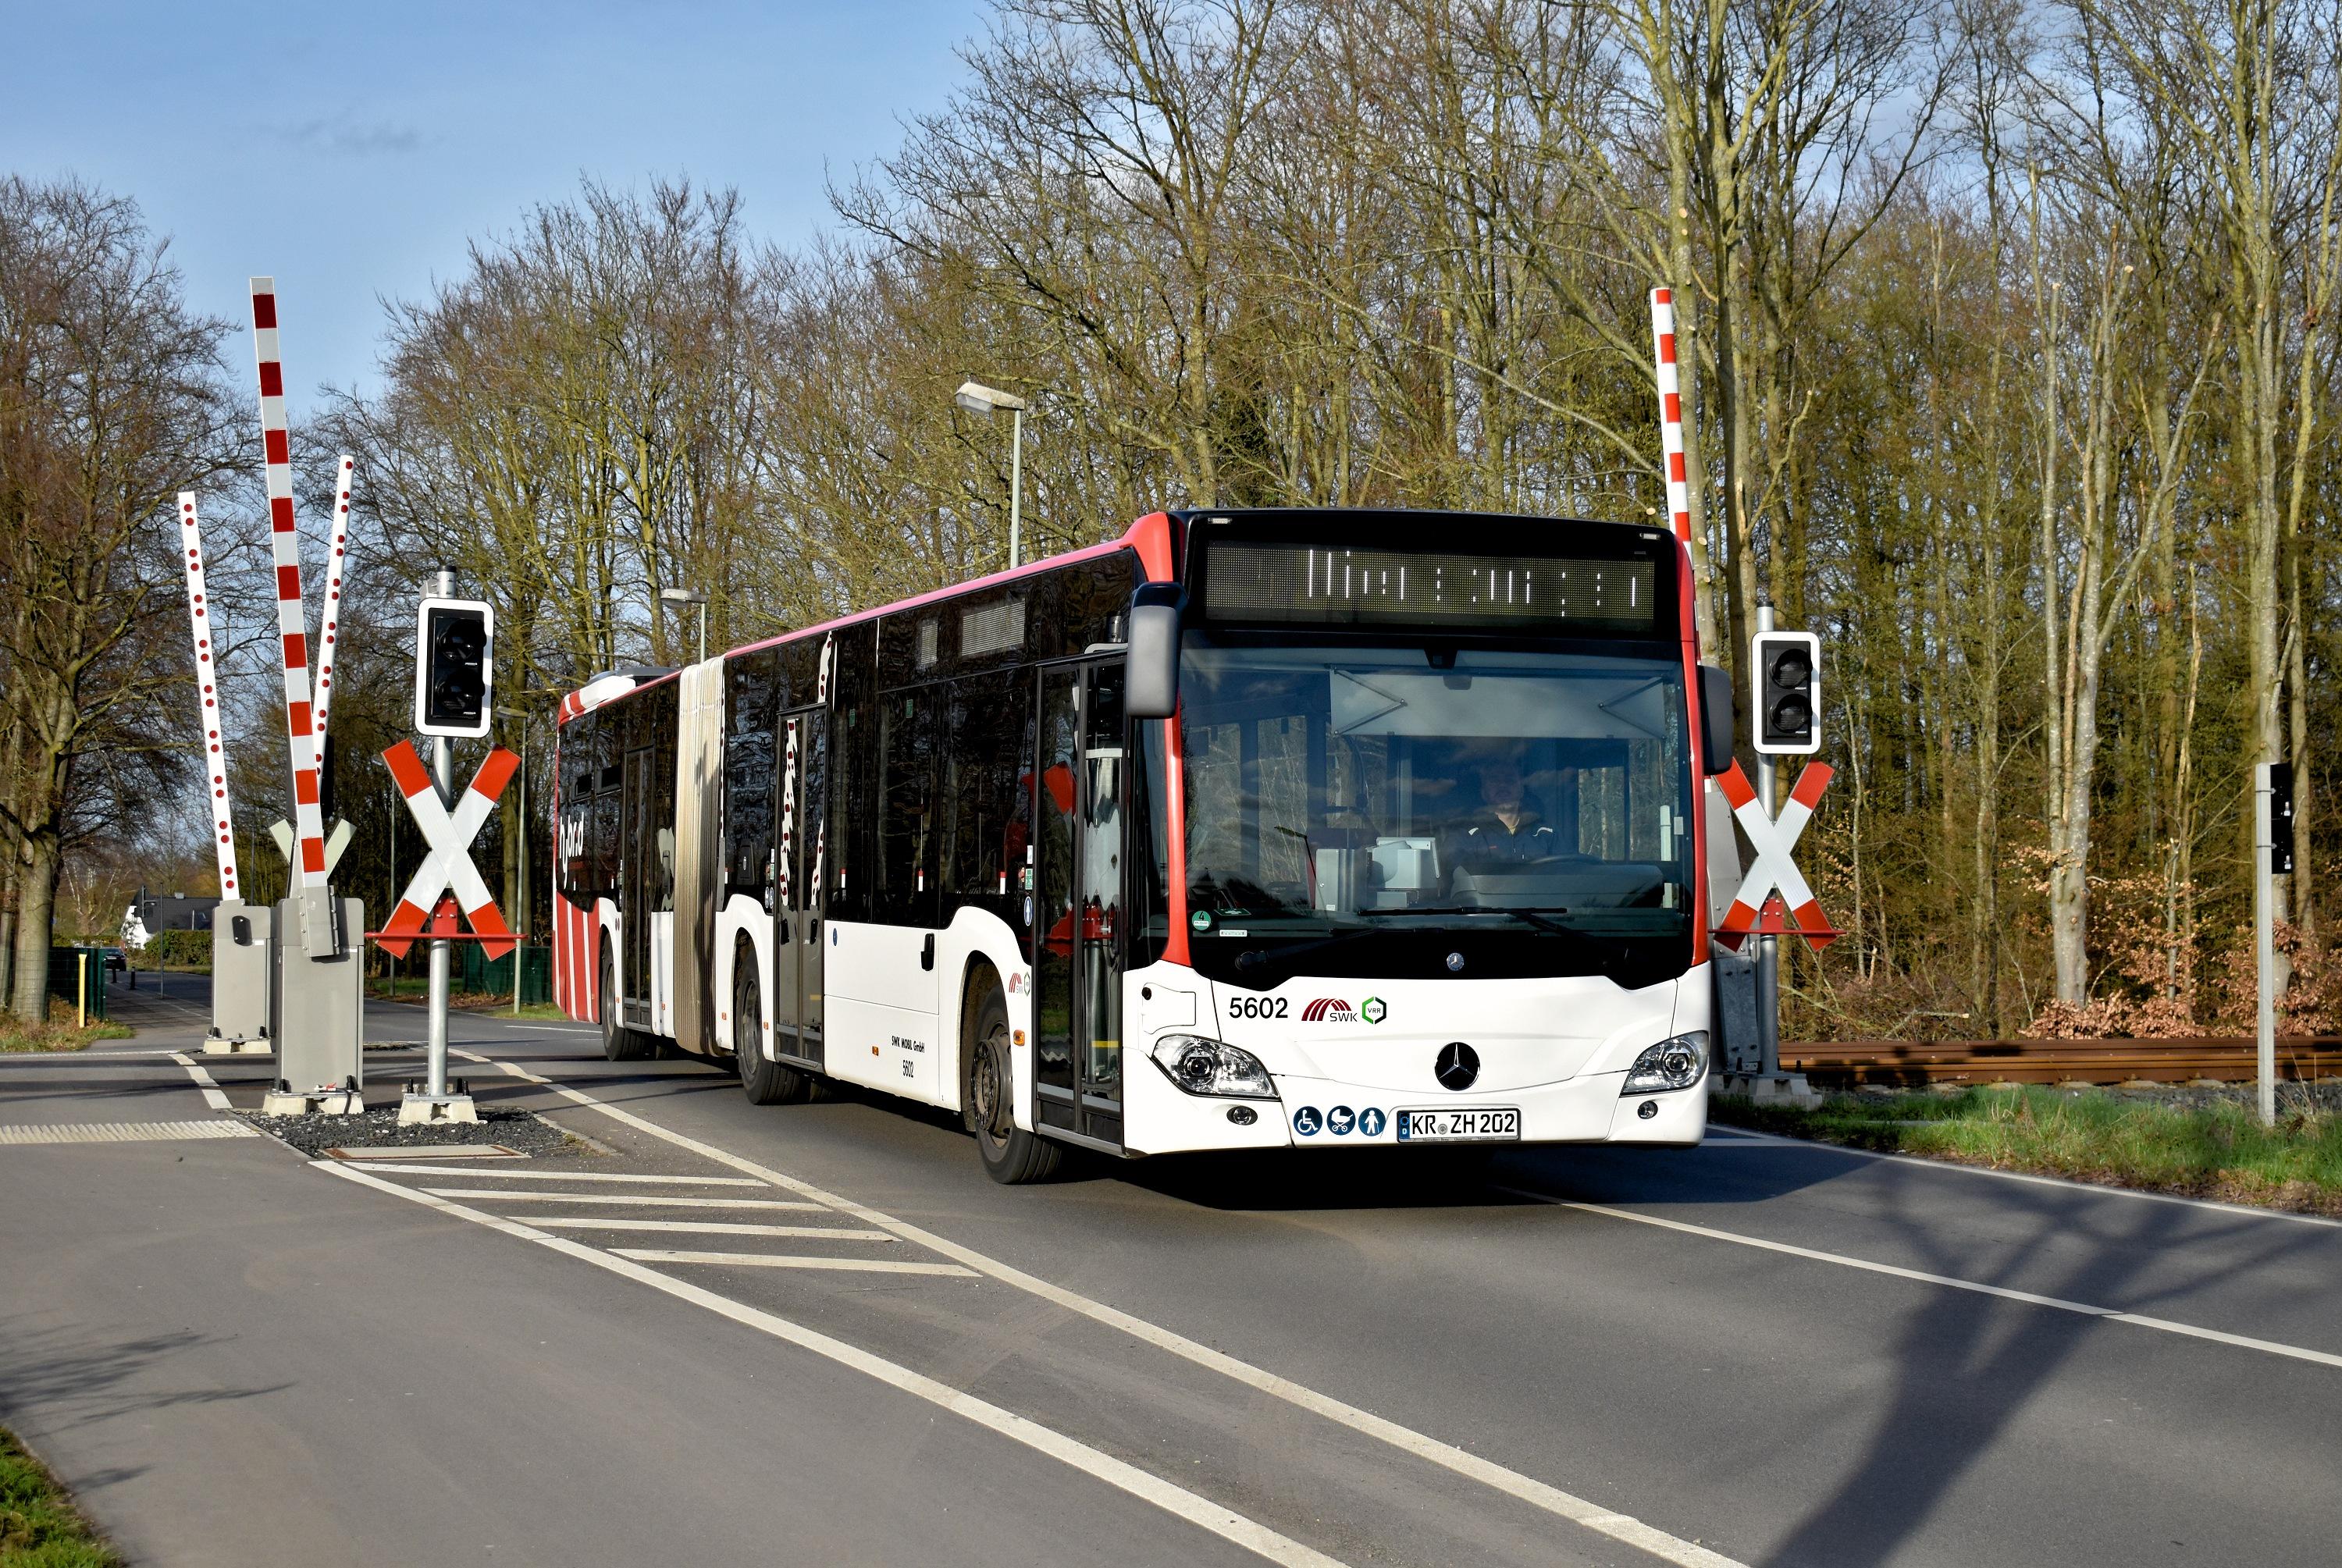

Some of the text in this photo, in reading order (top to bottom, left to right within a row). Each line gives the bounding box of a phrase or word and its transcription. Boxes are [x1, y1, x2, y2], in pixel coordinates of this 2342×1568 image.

[1198, 911, 1205, 920] 4
[1229, 997, 1288, 1019] 5602
[1329, 1012, 1358, 1022] SWK
[892, 1035, 925, 1054] SWK MOBIL GmbH
[902, 1059, 914, 1078] 5602
[1411, 1113, 1515, 1135] KR ZH 202
